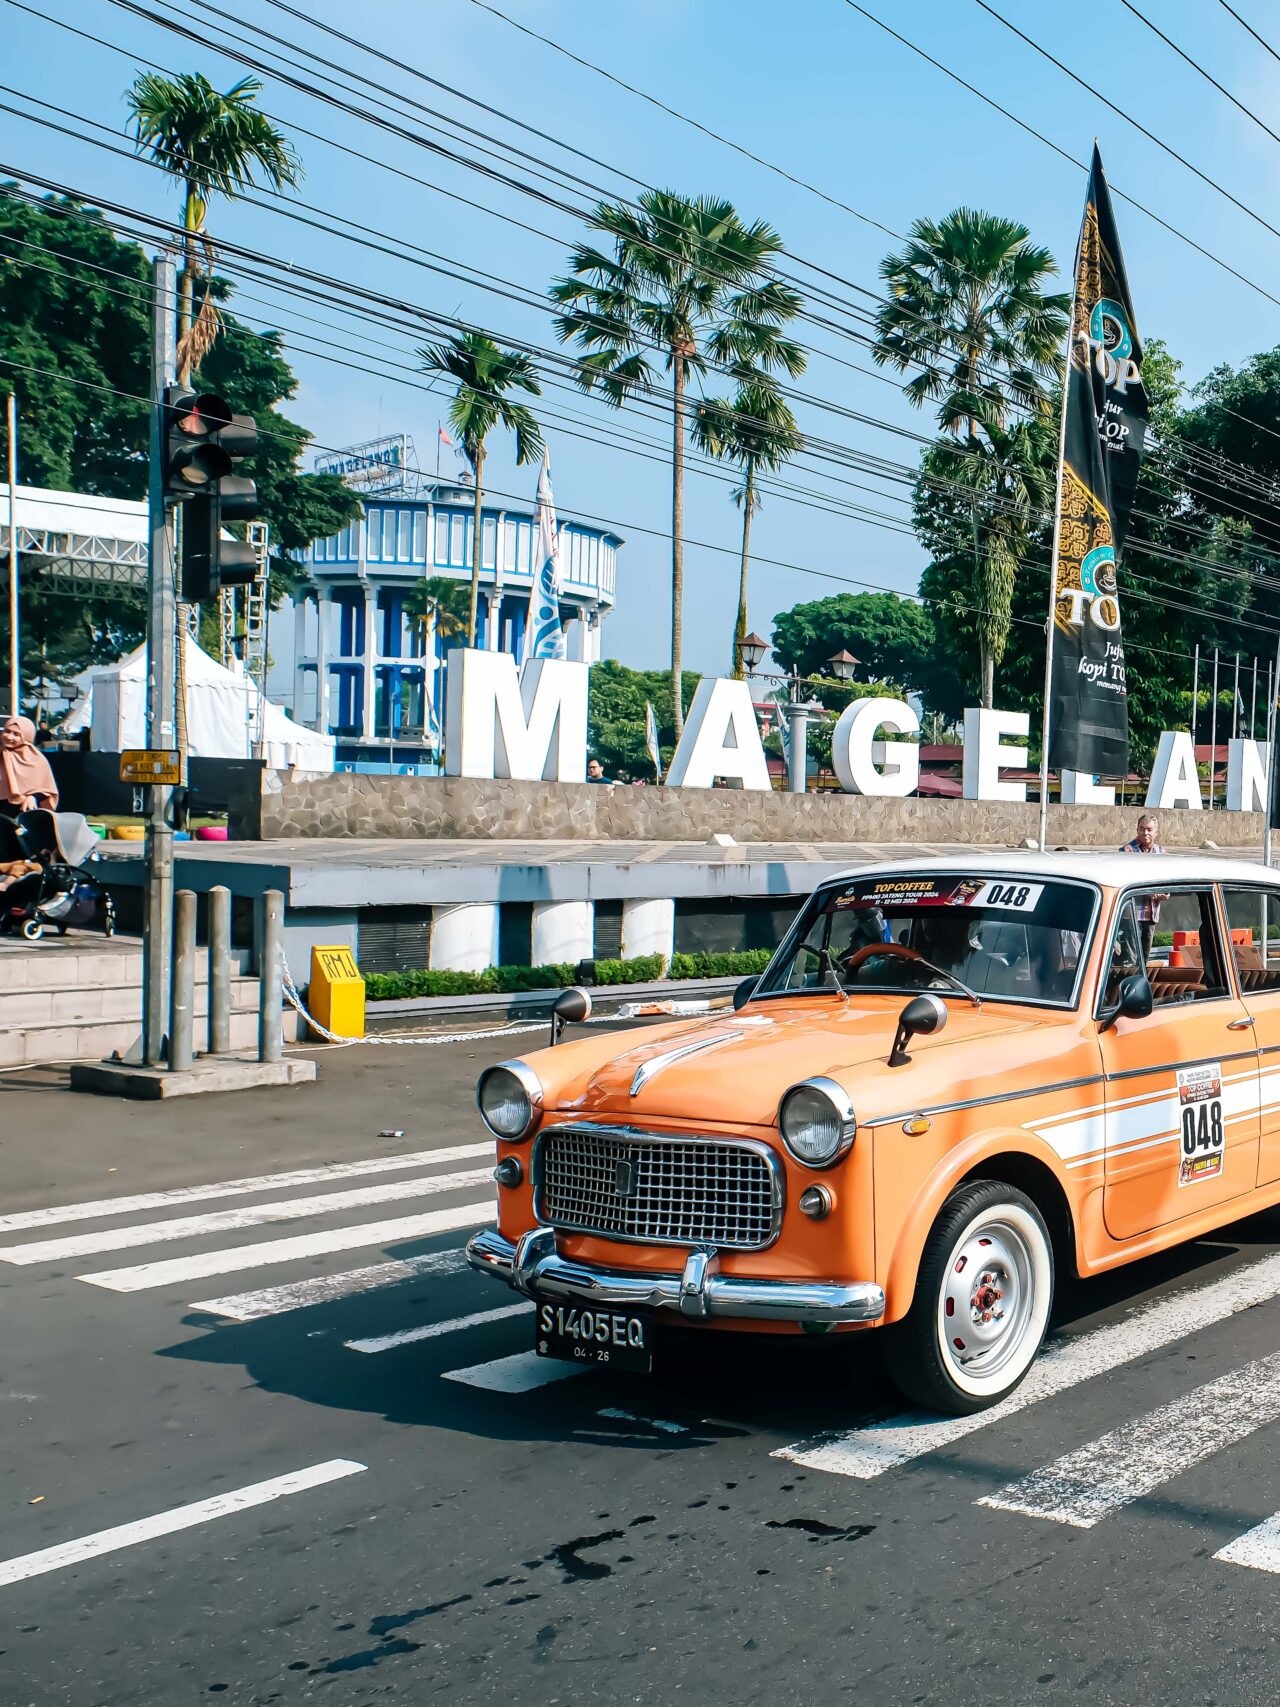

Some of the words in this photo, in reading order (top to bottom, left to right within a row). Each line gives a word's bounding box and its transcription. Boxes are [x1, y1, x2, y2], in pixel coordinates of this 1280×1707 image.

[1060, 587, 1122, 632] TO
[1077, 655, 1108, 682] kopi
[1110, 662, 1126, 683] TO
[874, 883, 894, 893] TOP
[894, 881, 935, 891] COFFEE
[986, 884, 1031, 907] 048
[321, 953, 358, 979] RMJ
[1182, 1100, 1223, 1155] 048
[597, 1350, 610, 1361] 26
